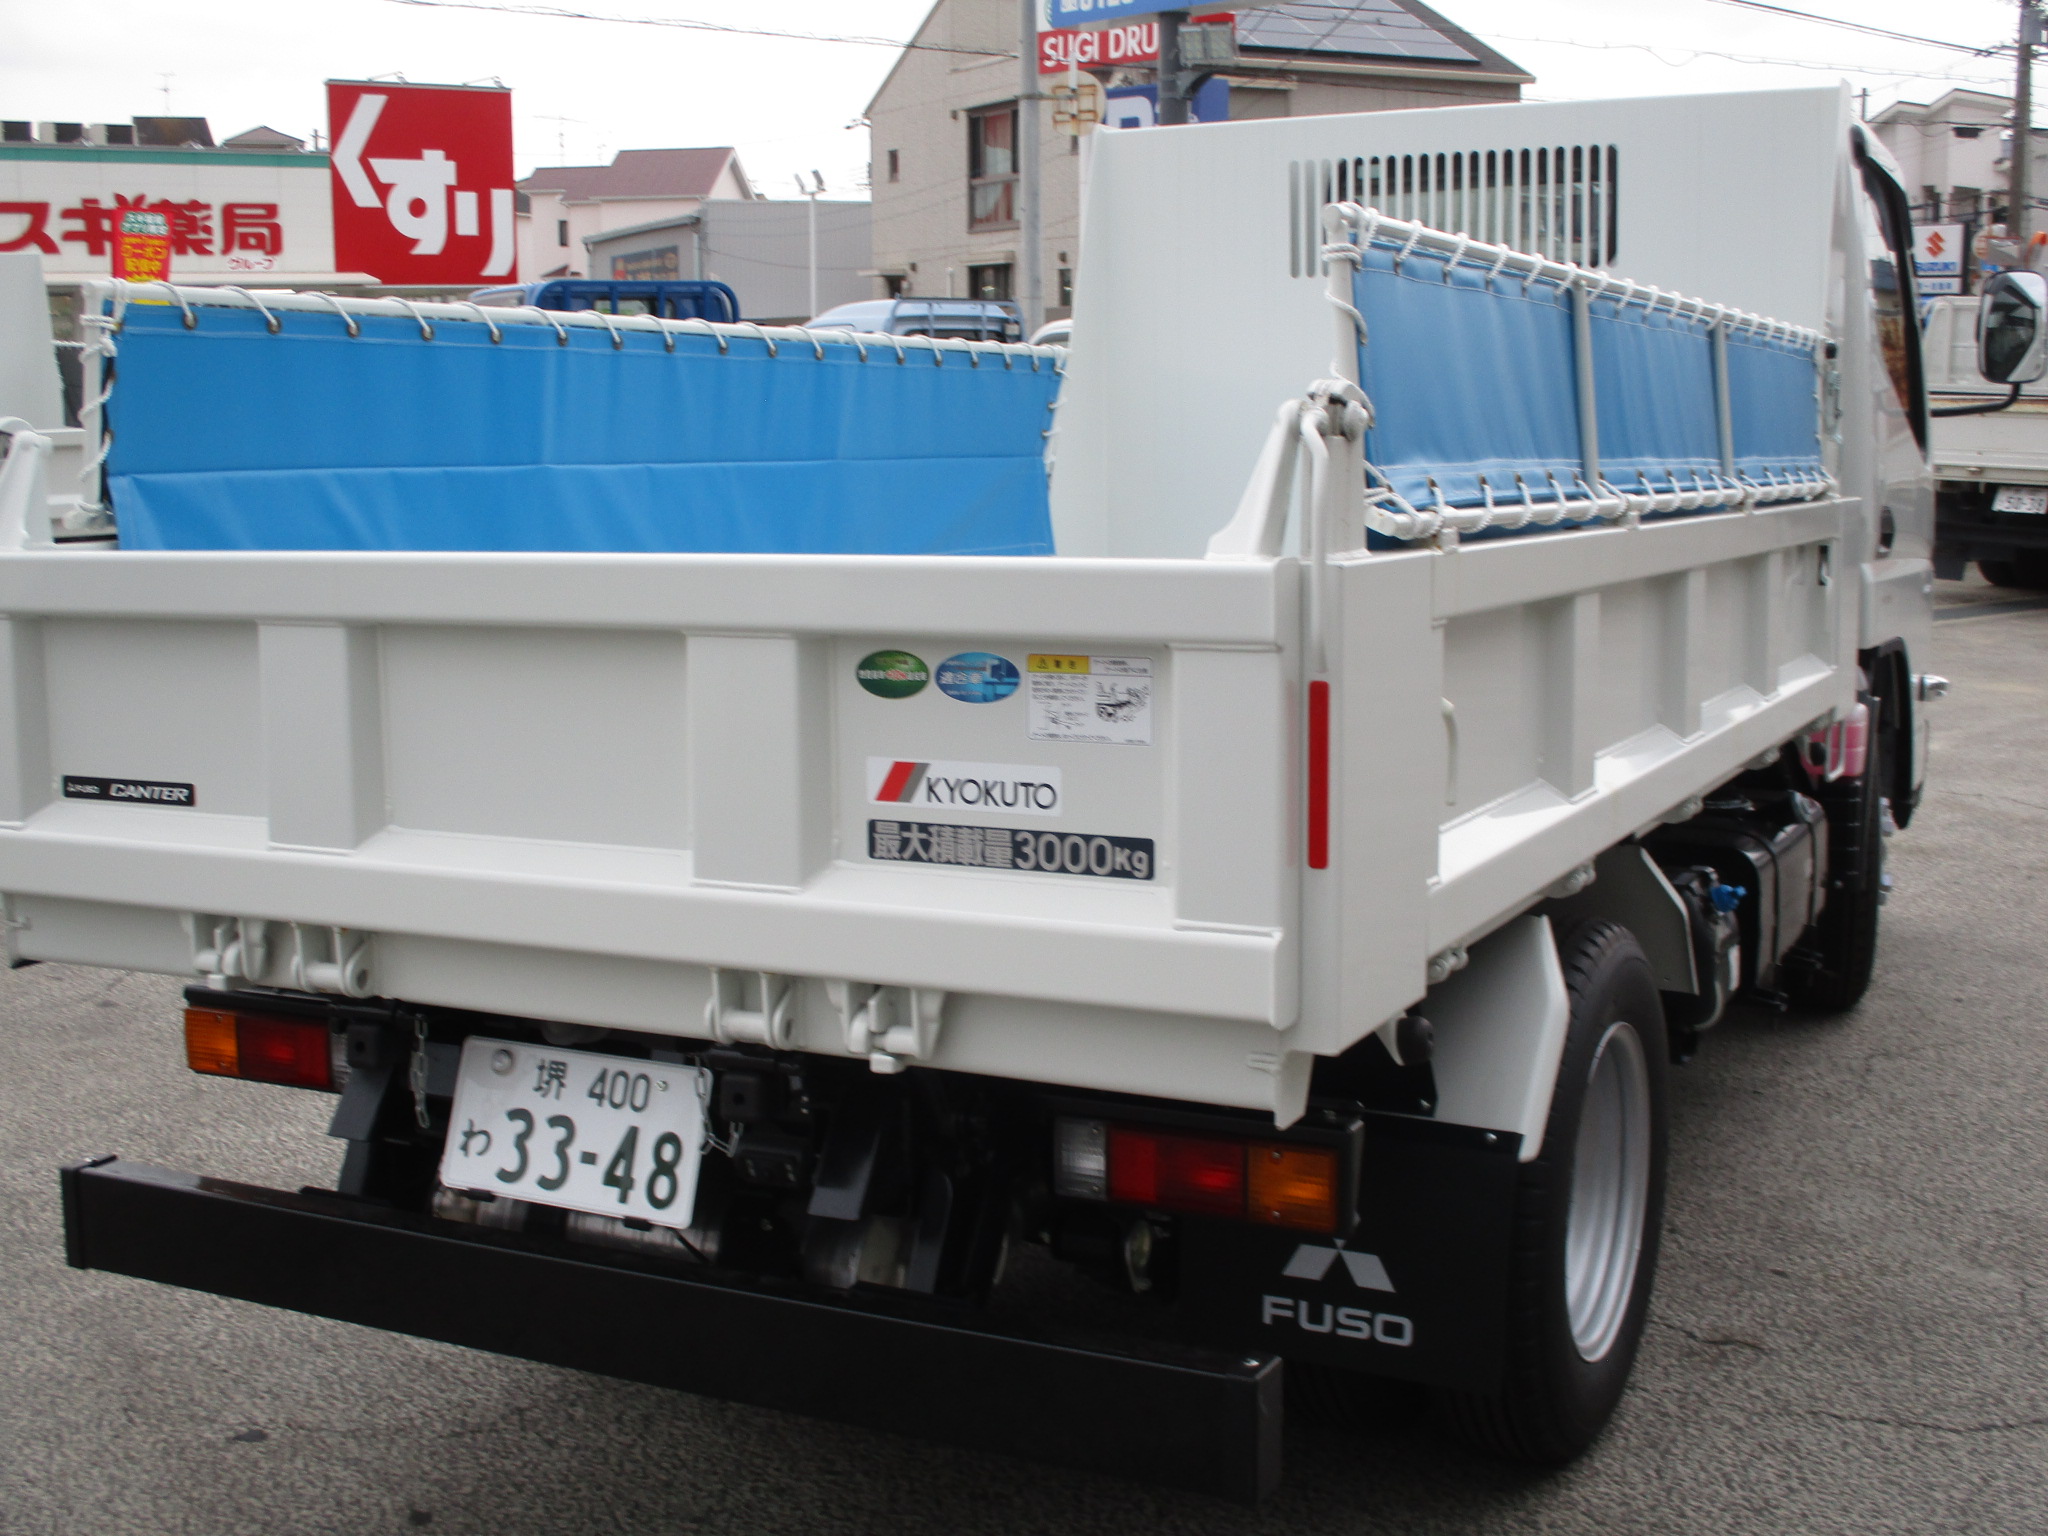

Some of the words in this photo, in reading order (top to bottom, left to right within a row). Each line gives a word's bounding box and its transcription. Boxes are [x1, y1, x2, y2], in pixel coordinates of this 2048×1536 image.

[1043, 31, 1100, 68] SUGI
[1108, 22, 1160, 60] DRU
[331, 94, 517, 277] くすり
[227, 255, 277, 271] グループ
[109, 783, 189, 801] CANTER
[925, 776, 1058, 810] KYOKUTO
[533, 1058, 569, 1100] 堺
[588, 1067, 651, 1113] 400
[460, 1119, 492, 1158] わ
[496, 1107, 683, 1210] 33-48
[1262, 1294, 1414, 1347] FUSO
